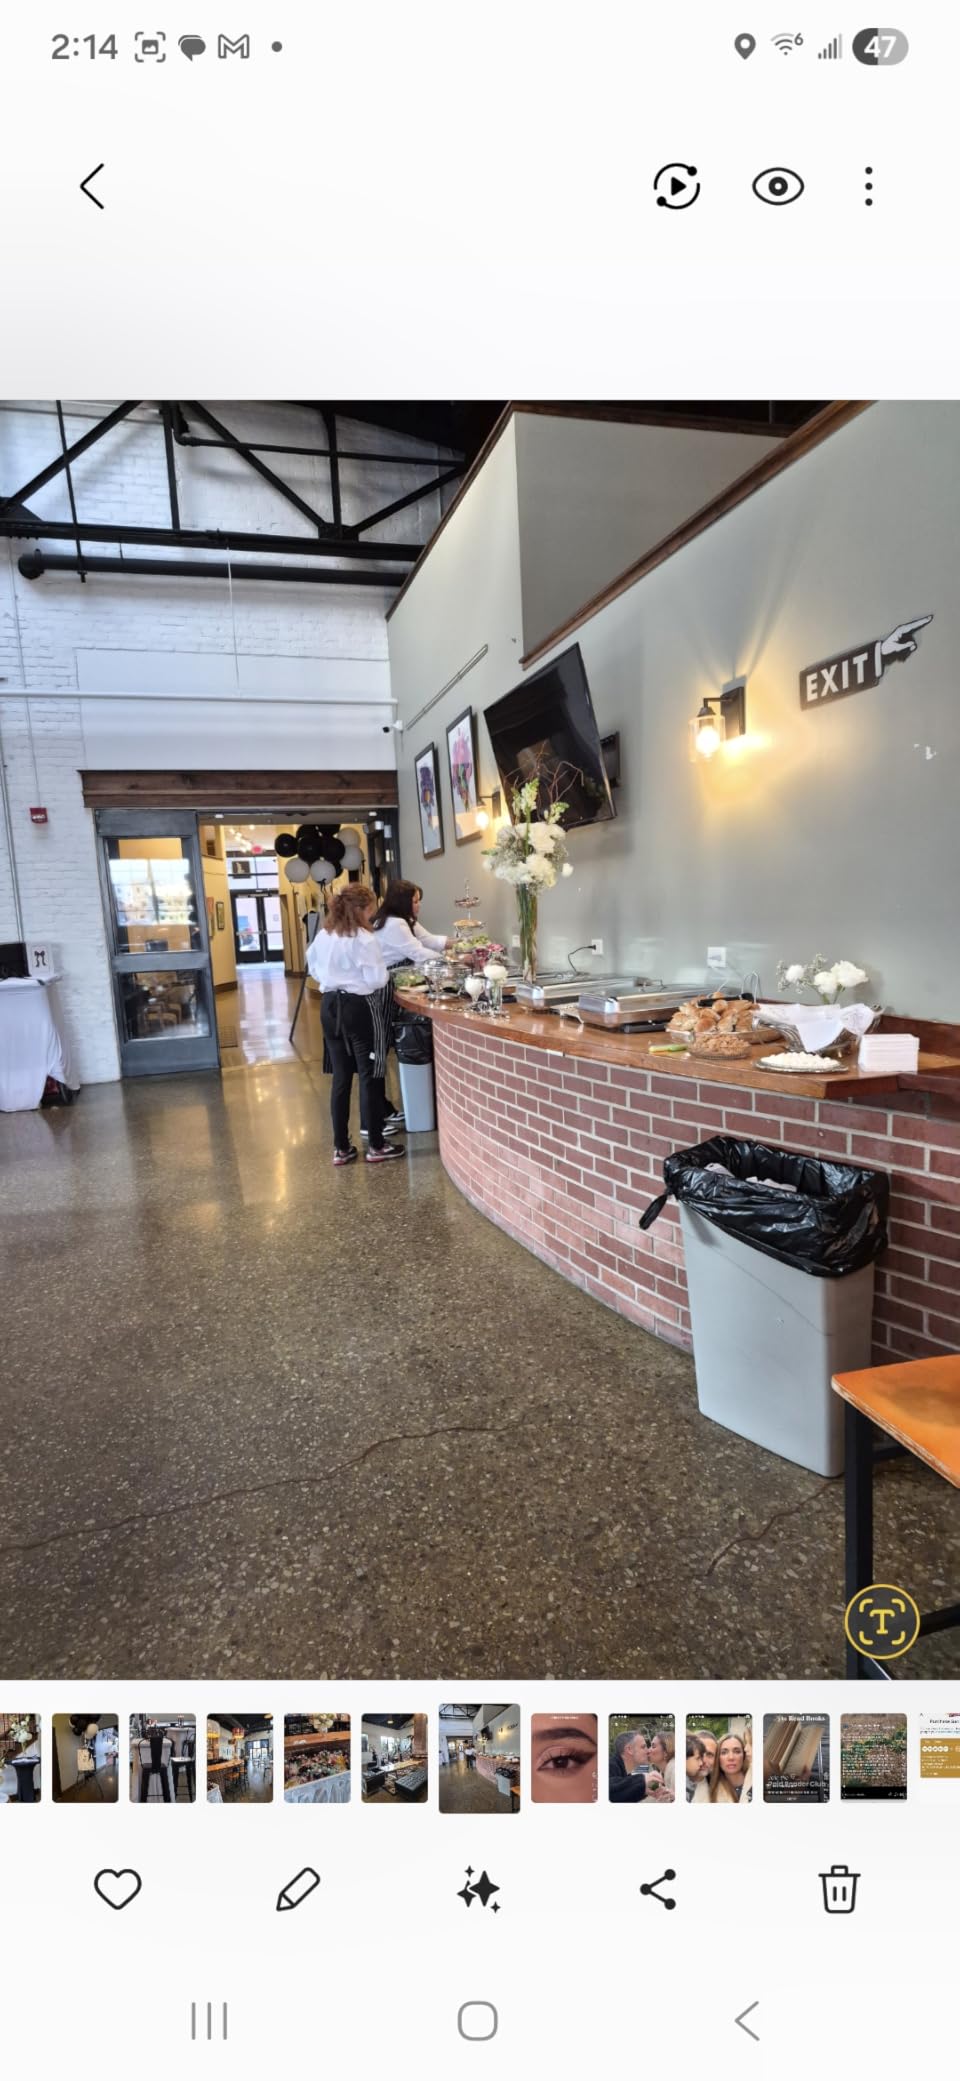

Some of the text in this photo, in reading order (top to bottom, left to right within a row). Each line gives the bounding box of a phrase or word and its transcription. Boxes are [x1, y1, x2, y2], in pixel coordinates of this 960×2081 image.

[52, 33, 118, 60] 2:14
[863, 35, 897, 58] 47
[806, 652, 868, 702] EXIT
